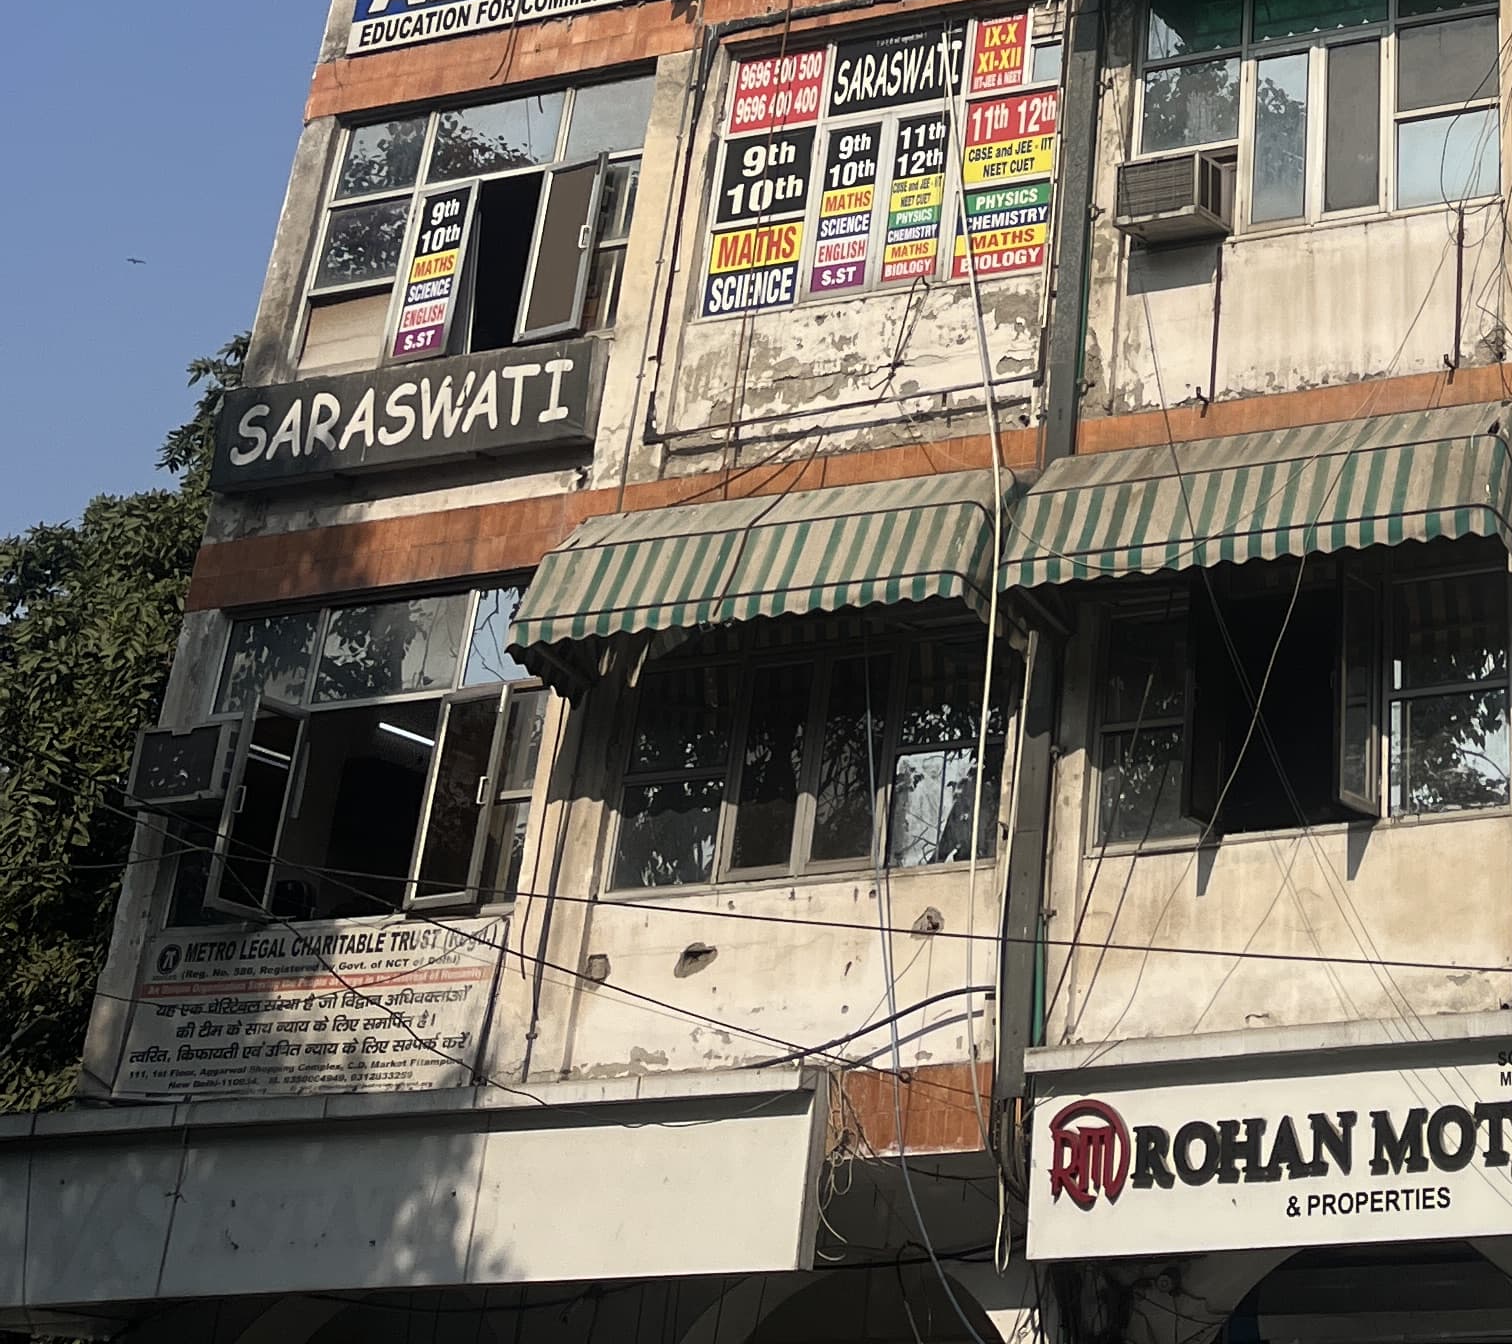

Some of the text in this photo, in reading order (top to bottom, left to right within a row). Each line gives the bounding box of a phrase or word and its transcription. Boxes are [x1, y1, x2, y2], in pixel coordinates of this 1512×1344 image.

[359, 4, 471, 47] EDUCATION
[984, 23, 1018, 49] IX-X
[833, 39, 963, 106] SARASWATI
[977, 47, 1022, 74] XI-XII
[972, 95, 1057, 142] 11th 12th
[742, 140, 796, 177] 9th
[838, 131, 872, 160] 9th
[829, 158, 875, 189] 10th
[898, 148, 944, 176] 12th
[727, 176, 804, 215] 10th
[825, 191, 872, 217] MATHS
[975, 188, 1038, 211] PHYSICS
[430, 198, 460, 226] 9th
[421, 223, 461, 254] 10th
[717, 226, 797, 269] MATHS
[818, 234, 866, 262] ENGLISH
[414, 253, 455, 279] MATHS
[407, 277, 451, 303] SCIENCE
[709, 266, 794, 313] SCIENCE
[403, 303, 445, 329] ENGLISH
[403, 330, 435, 350] S.ST
[229, 358, 574, 466] SARASWATI
[185, 928, 441, 963] METRO LEGAL CHARITABLE TRUST
[176, 1014, 360, 1038] की टीम साथ न्याय लिए
[176, 1042, 239, 1063] किफायती
[1131, 1110, 1357, 1190] ROHAN
[1286, 1187, 1451, 1218] & PROPERTIES
